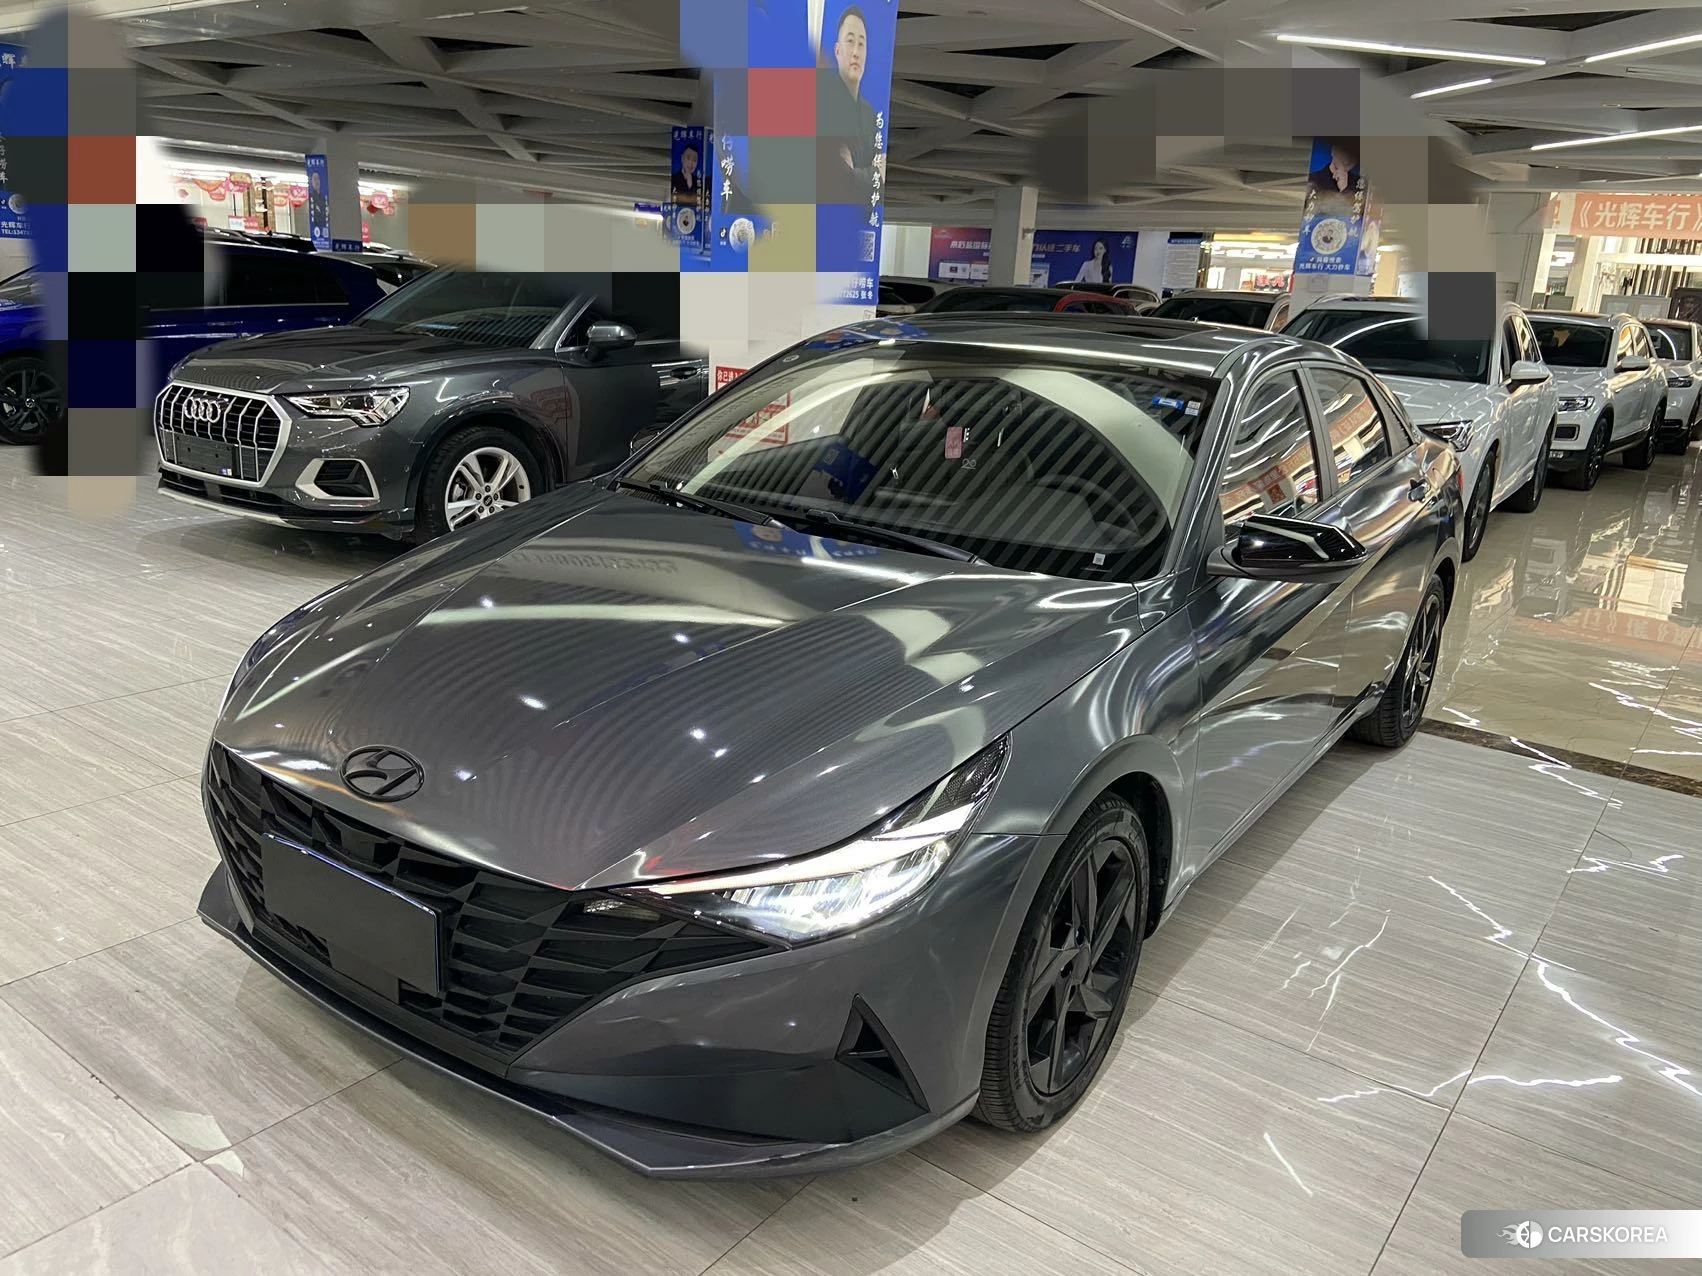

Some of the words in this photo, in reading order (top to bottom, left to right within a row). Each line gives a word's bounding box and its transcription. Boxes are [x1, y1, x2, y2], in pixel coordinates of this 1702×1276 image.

[869, 111, 884, 228] 为您保驾护航
